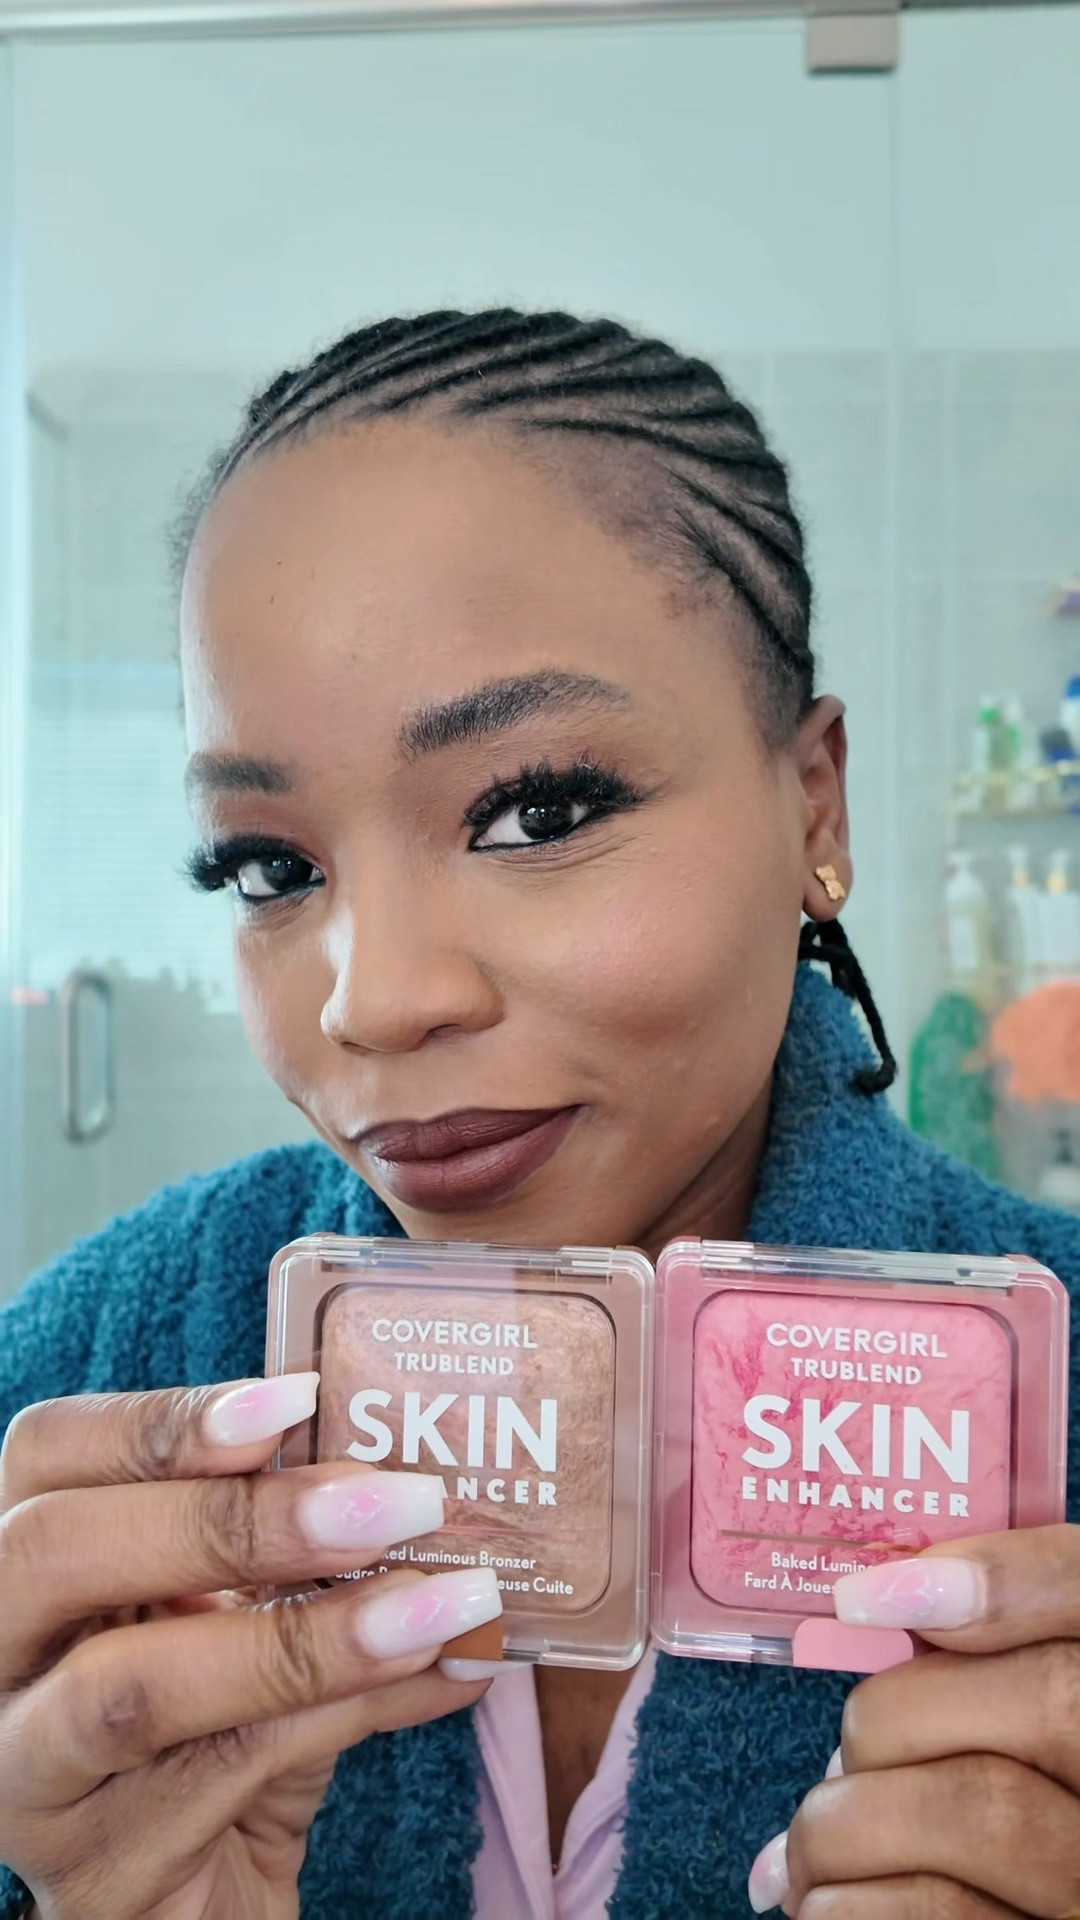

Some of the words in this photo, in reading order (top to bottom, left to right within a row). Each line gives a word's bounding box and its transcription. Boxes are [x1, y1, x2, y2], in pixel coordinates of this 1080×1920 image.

[372, 1318, 538, 1349] COVERGIRL
[766, 1322, 948, 1359] COVERGIRL
[394, 1352, 514, 1376] TRUBLEND
[790, 1357, 922, 1385] TRUBLEND
[346, 1388, 558, 1473] SKIN
[742, 1394, 970, 1484] SKIN
[440, 1476, 558, 1506] NCER
[742, 1476, 970, 1517] ENHANCER
[410, 1546, 476, 1566] Luminous
[479, 1550, 537, 1570] Bronzer
[771, 1551, 818, 1571] Baked
[820, 1555, 874, 1574] Lumin
[497, 1579, 530, 1592] euse
[532, 1576, 574, 1595] Cuite
[744, 1571, 777, 1589] Fard
[780, 1571, 793, 1591] À
